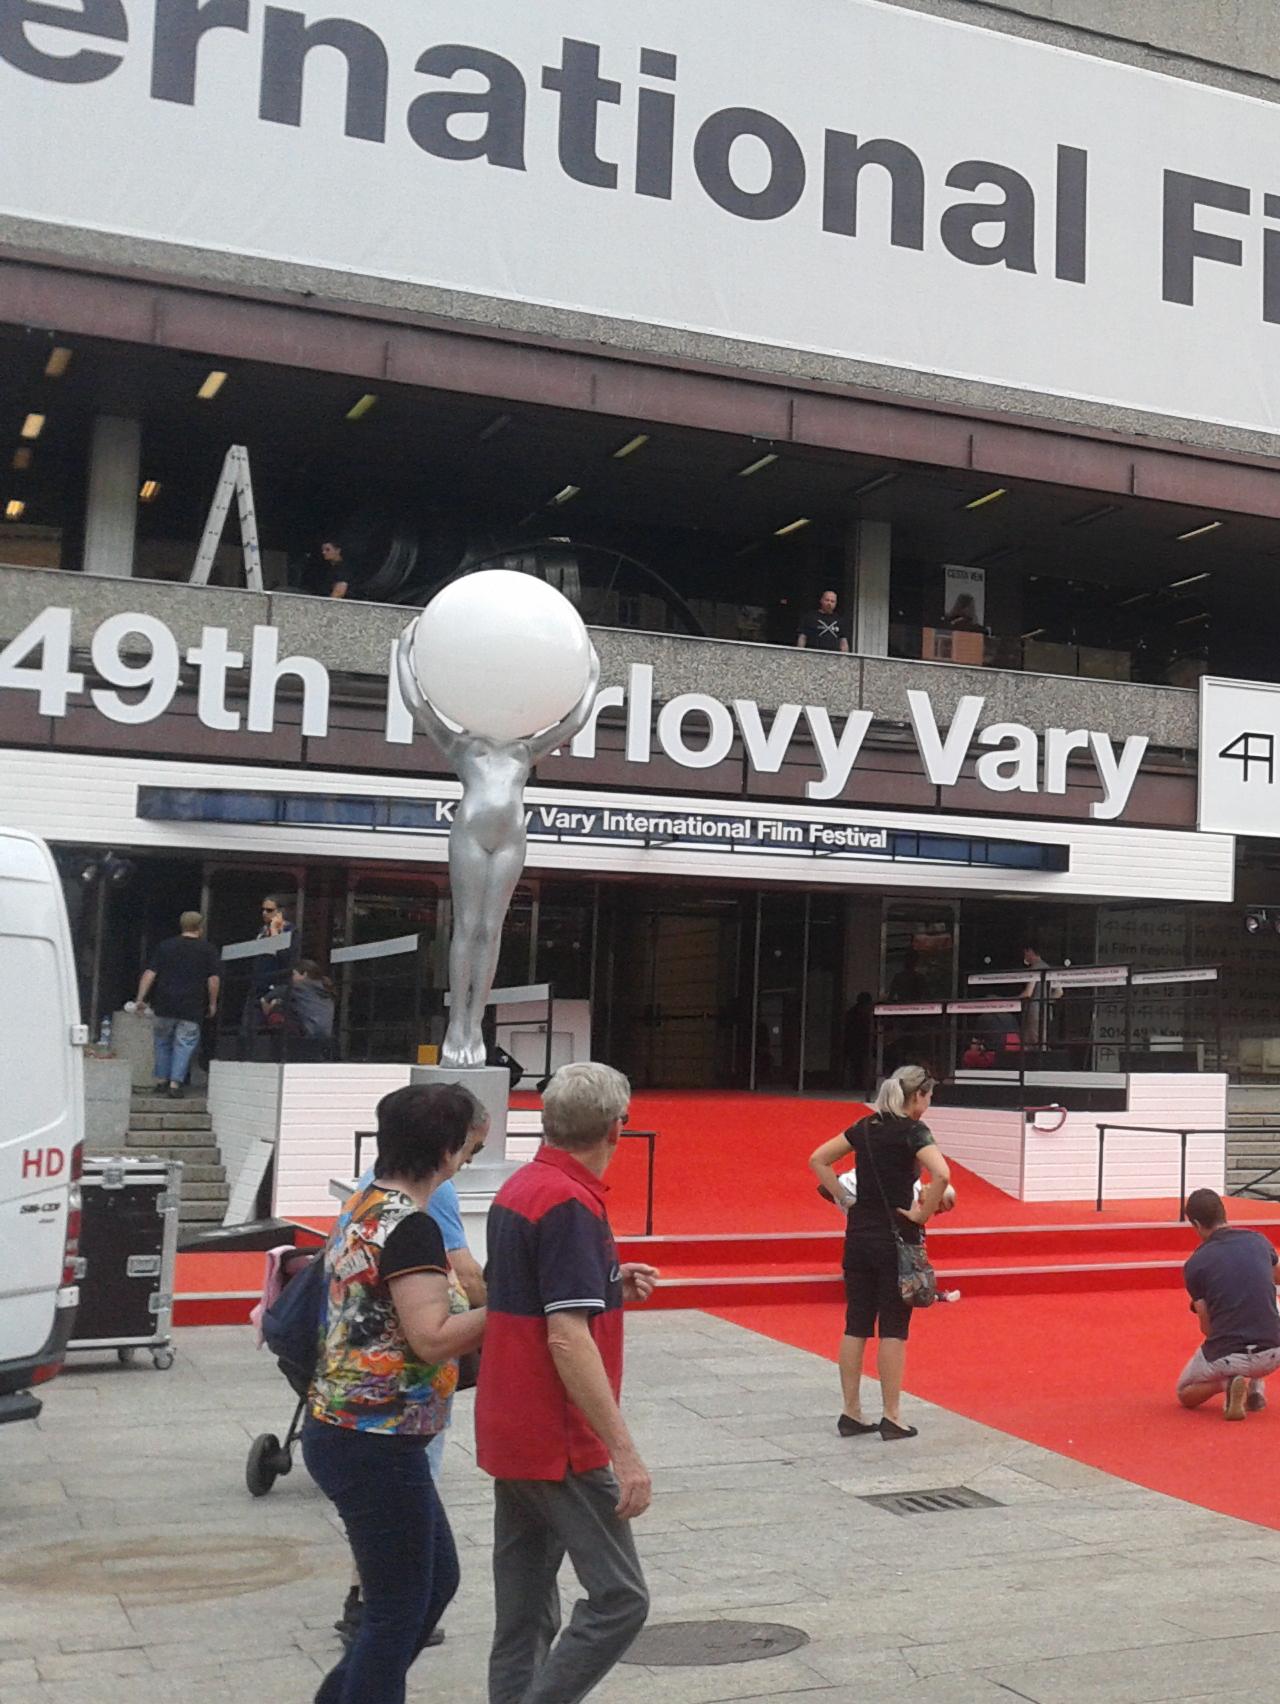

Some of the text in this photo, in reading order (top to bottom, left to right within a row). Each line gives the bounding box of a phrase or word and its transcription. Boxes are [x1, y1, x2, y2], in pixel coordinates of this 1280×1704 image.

[0, 606, 1150, 820] 49th rlovy Vary
[540, 806, 596, 834] Vary
[602, 810, 751, 839] International
[757, 820, 803, 843] Film
[808, 824, 888, 849] Festival
[21, 1148, 65, 1179] HD
